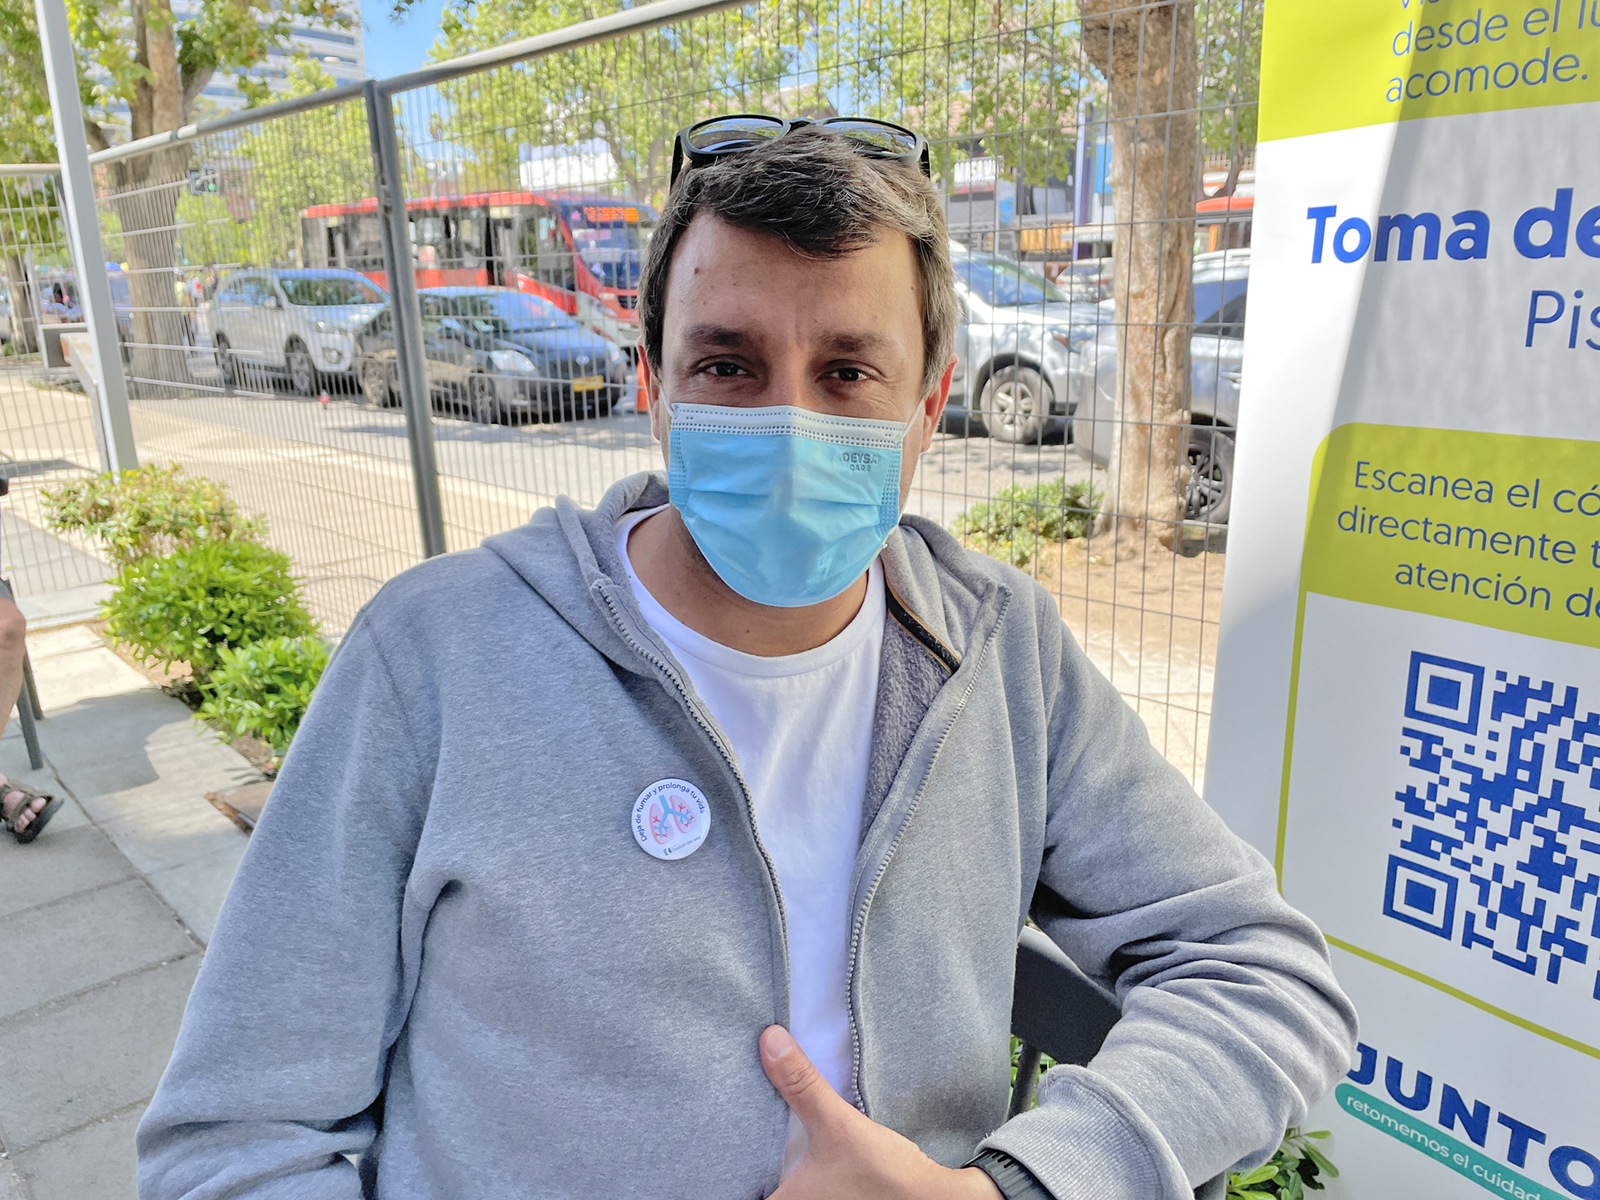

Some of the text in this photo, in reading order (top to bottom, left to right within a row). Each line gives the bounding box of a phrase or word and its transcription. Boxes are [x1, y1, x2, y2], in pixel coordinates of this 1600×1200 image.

[1392, 8, 1509, 56] desde
[1523, 0, 1562, 36] el
[1386, 47, 1589, 103] acomode.
[1306, 204, 1491, 264] Toma
[842, 452, 877, 464] DEYSA
[850, 464, 871, 472] CARE
[1355, 461, 1600, 516] Escanea el có
[1338, 505, 1576, 564] directamente
[1395, 562, 1600, 619] atención d
[636, 792, 652, 812] fumar
[658, 782, 690, 793] prolonga
[690, 790, 697, 799] tu
[635, 813, 641, 824] de
[637, 825, 647, 842] Deja
[1346, 1042, 1600, 1200] JUNTO
[1346, 1096, 1450, 1158] retomemos
[1453, 1153, 1469, 1169] el
